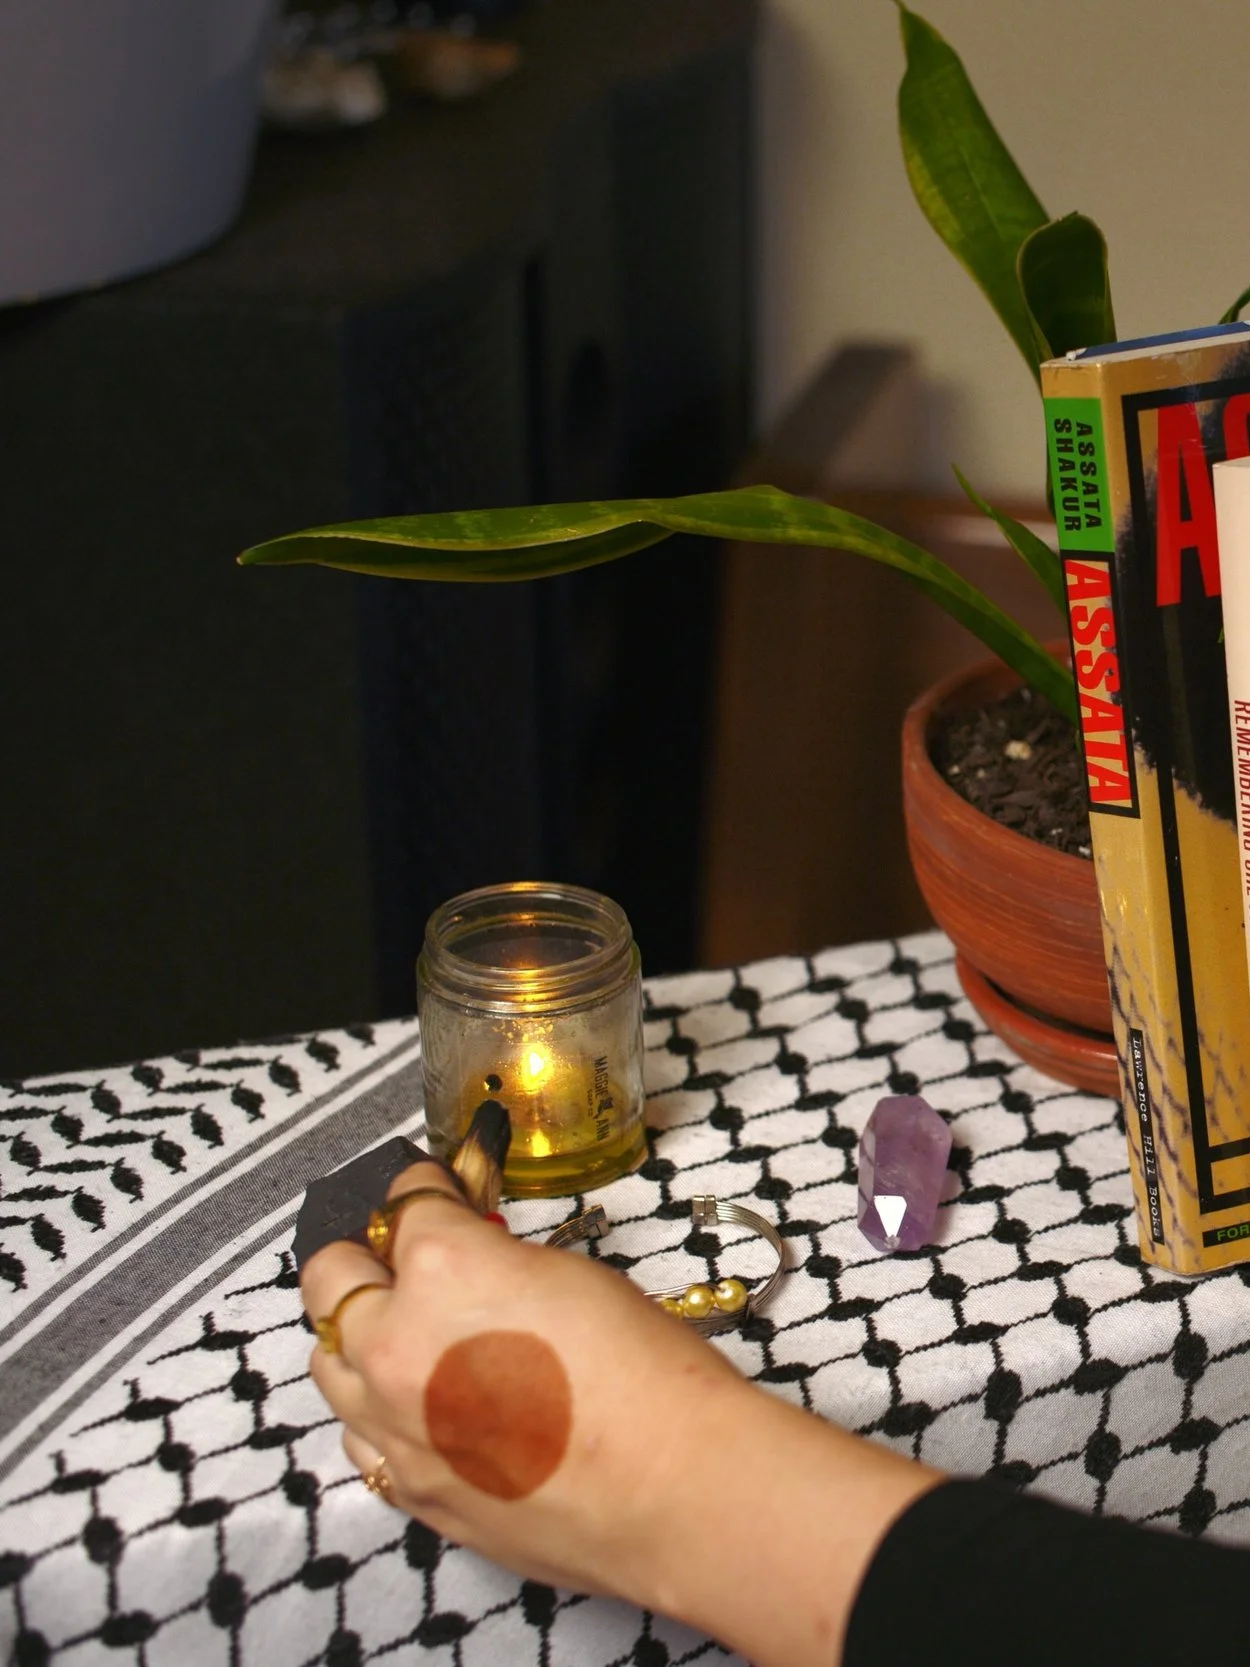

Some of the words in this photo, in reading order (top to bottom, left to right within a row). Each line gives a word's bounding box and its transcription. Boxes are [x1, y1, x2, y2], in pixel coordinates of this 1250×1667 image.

[1053, 418, 1082, 532] SHAKUR
[1076, 421, 1102, 529] ASSATA
[1064, 559, 1132, 804] ASSATA
[594, 1055, 609, 1099] MAGGIE
[596, 1118, 610, 1142] ANN
[1133, 1037, 1148, 1122] Lawrence
[1143, 1136, 1153, 1176] Hill
[1149, 1186, 1160, 1237] Books
